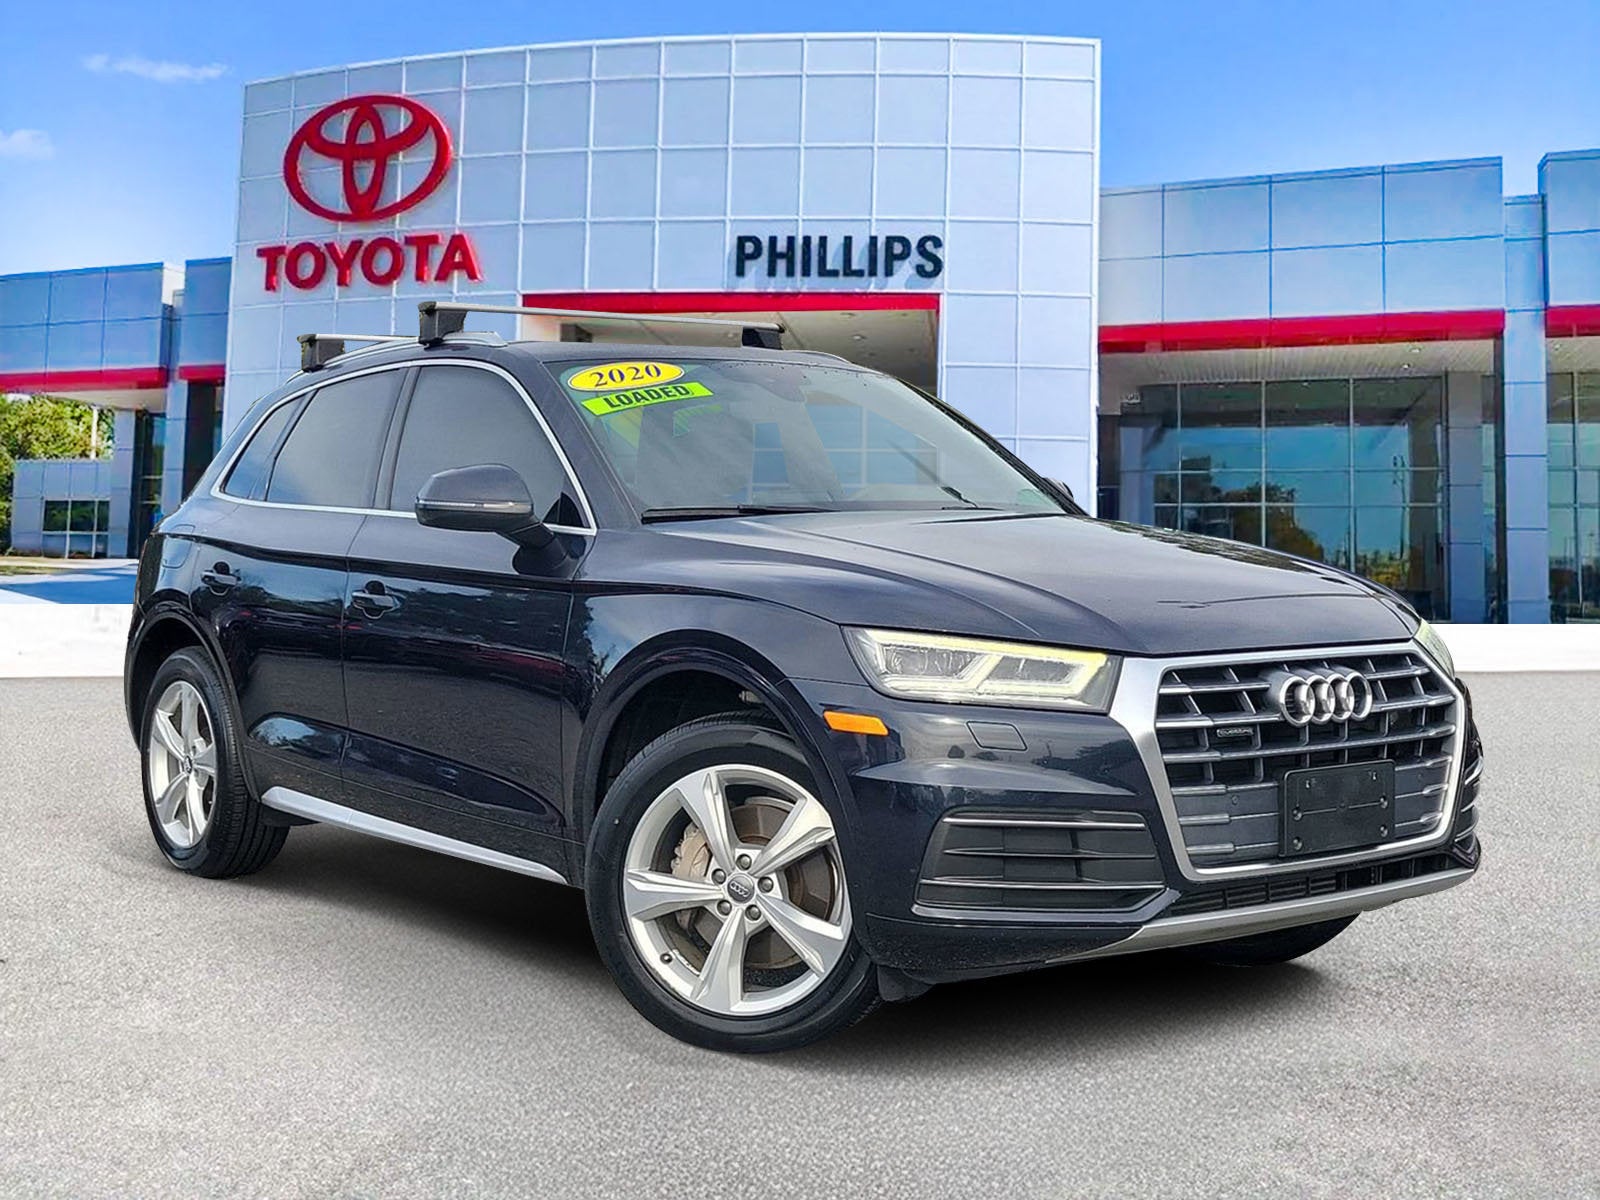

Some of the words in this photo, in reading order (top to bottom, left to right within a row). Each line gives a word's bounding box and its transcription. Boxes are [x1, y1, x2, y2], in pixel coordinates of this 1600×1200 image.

[257, 234, 481, 291] TOYOTA
[735, 234, 943, 278] PHILLIPS
[590, 364, 662, 387] 2020
[603, 384, 690, 408] LOADED
